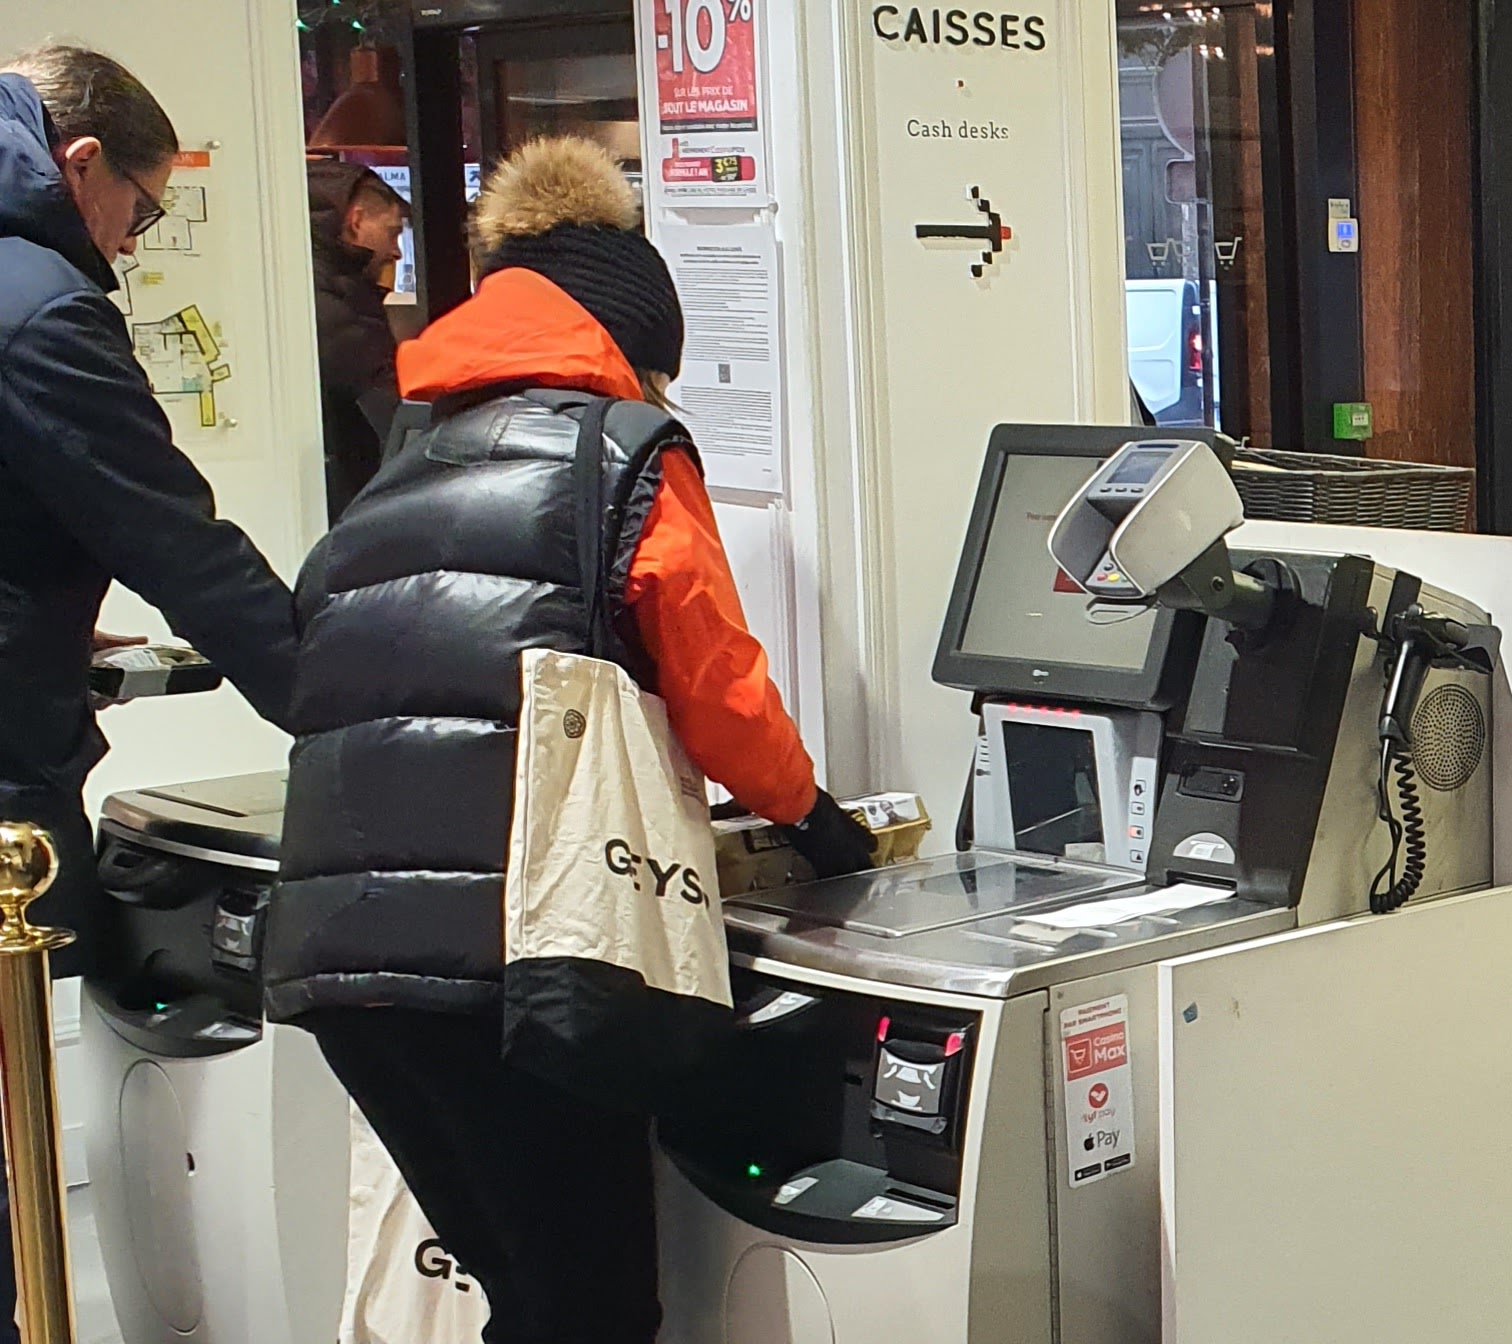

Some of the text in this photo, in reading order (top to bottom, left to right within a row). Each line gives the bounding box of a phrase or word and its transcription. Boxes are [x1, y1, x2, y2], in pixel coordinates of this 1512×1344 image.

[873, 5, 1046, 51] CAISSES
[702, 85, 720, 96] PRIX
[722, 85, 733, 96] DE
[686, 101, 698, 114] LE
[698, 99, 748, 112] MAGASIN
[907, 120, 1009, 139] Cash desks
[1094, 1031, 1124, 1046] Casino
[1095, 1044, 1125, 1064] Max
[1097, 1129, 1120, 1149] Pay
